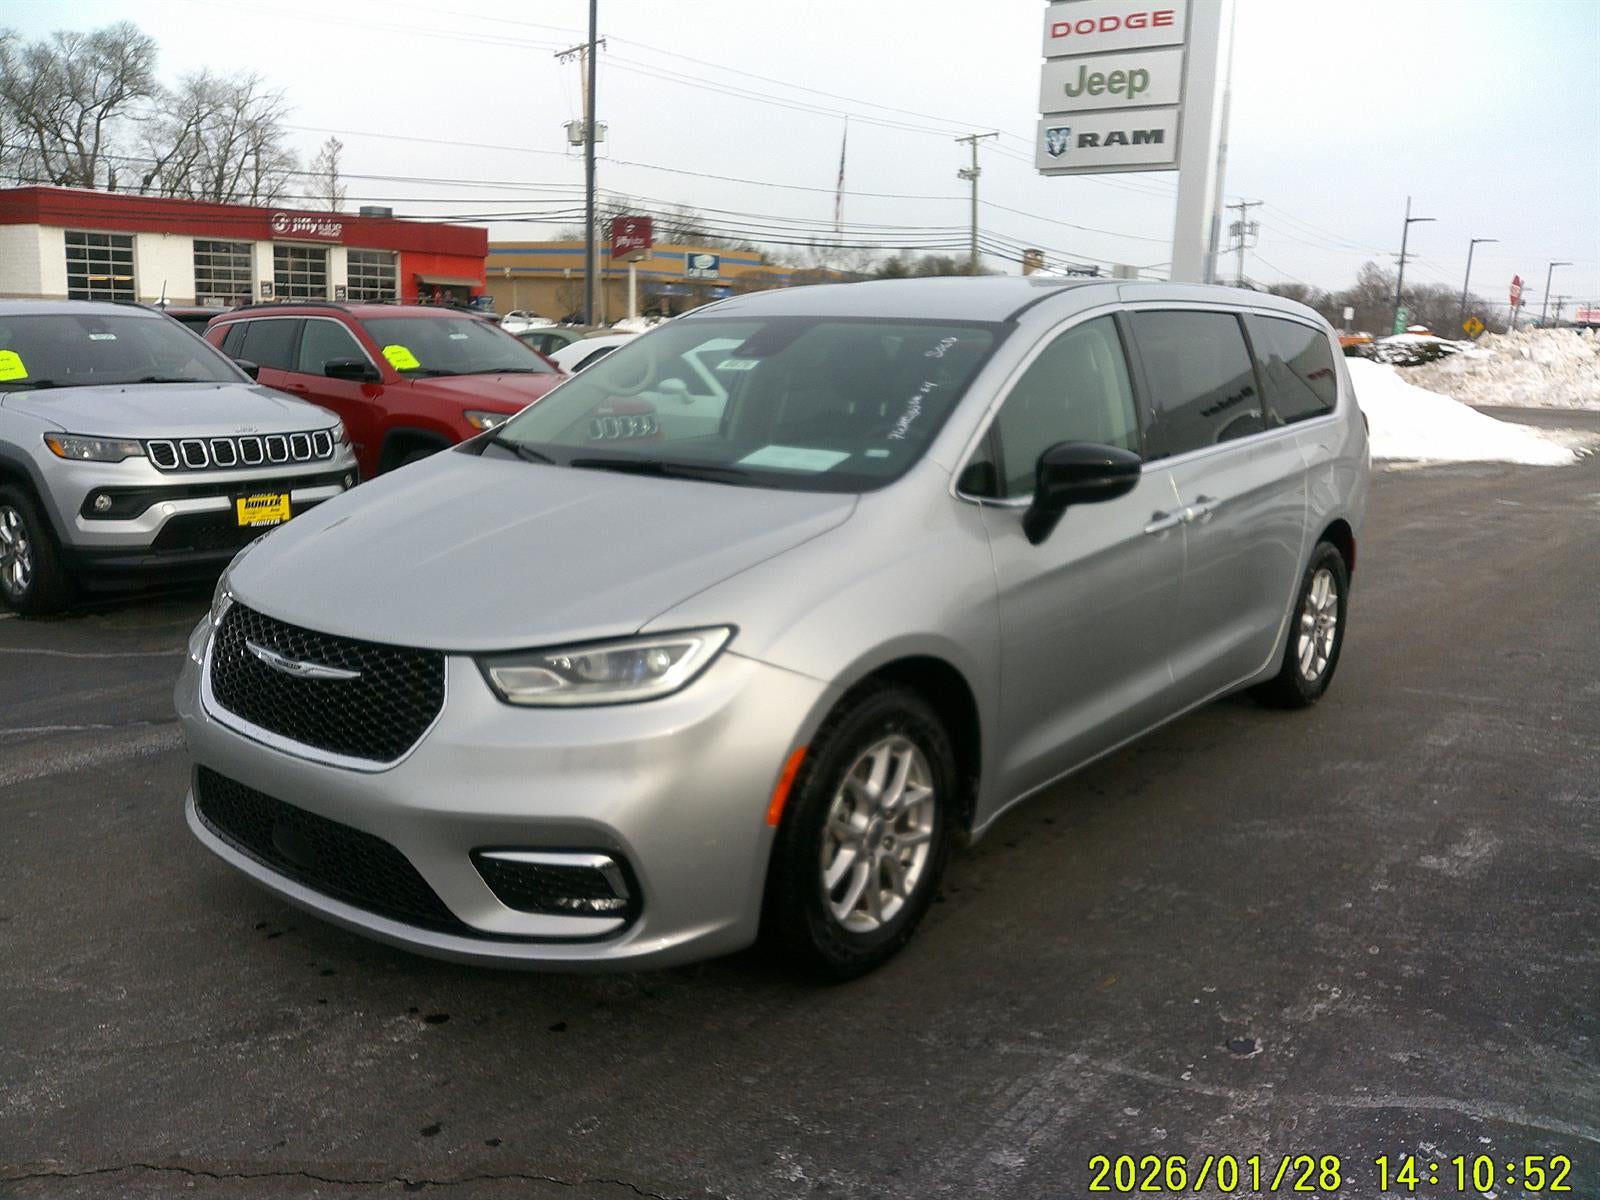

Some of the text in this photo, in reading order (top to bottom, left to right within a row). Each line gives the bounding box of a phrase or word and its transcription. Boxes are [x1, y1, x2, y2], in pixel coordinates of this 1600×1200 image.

[1051, 10, 1175, 38] DODGE
[1064, 65, 1149, 99] Jeep
[1077, 129, 1165, 148] RAM
